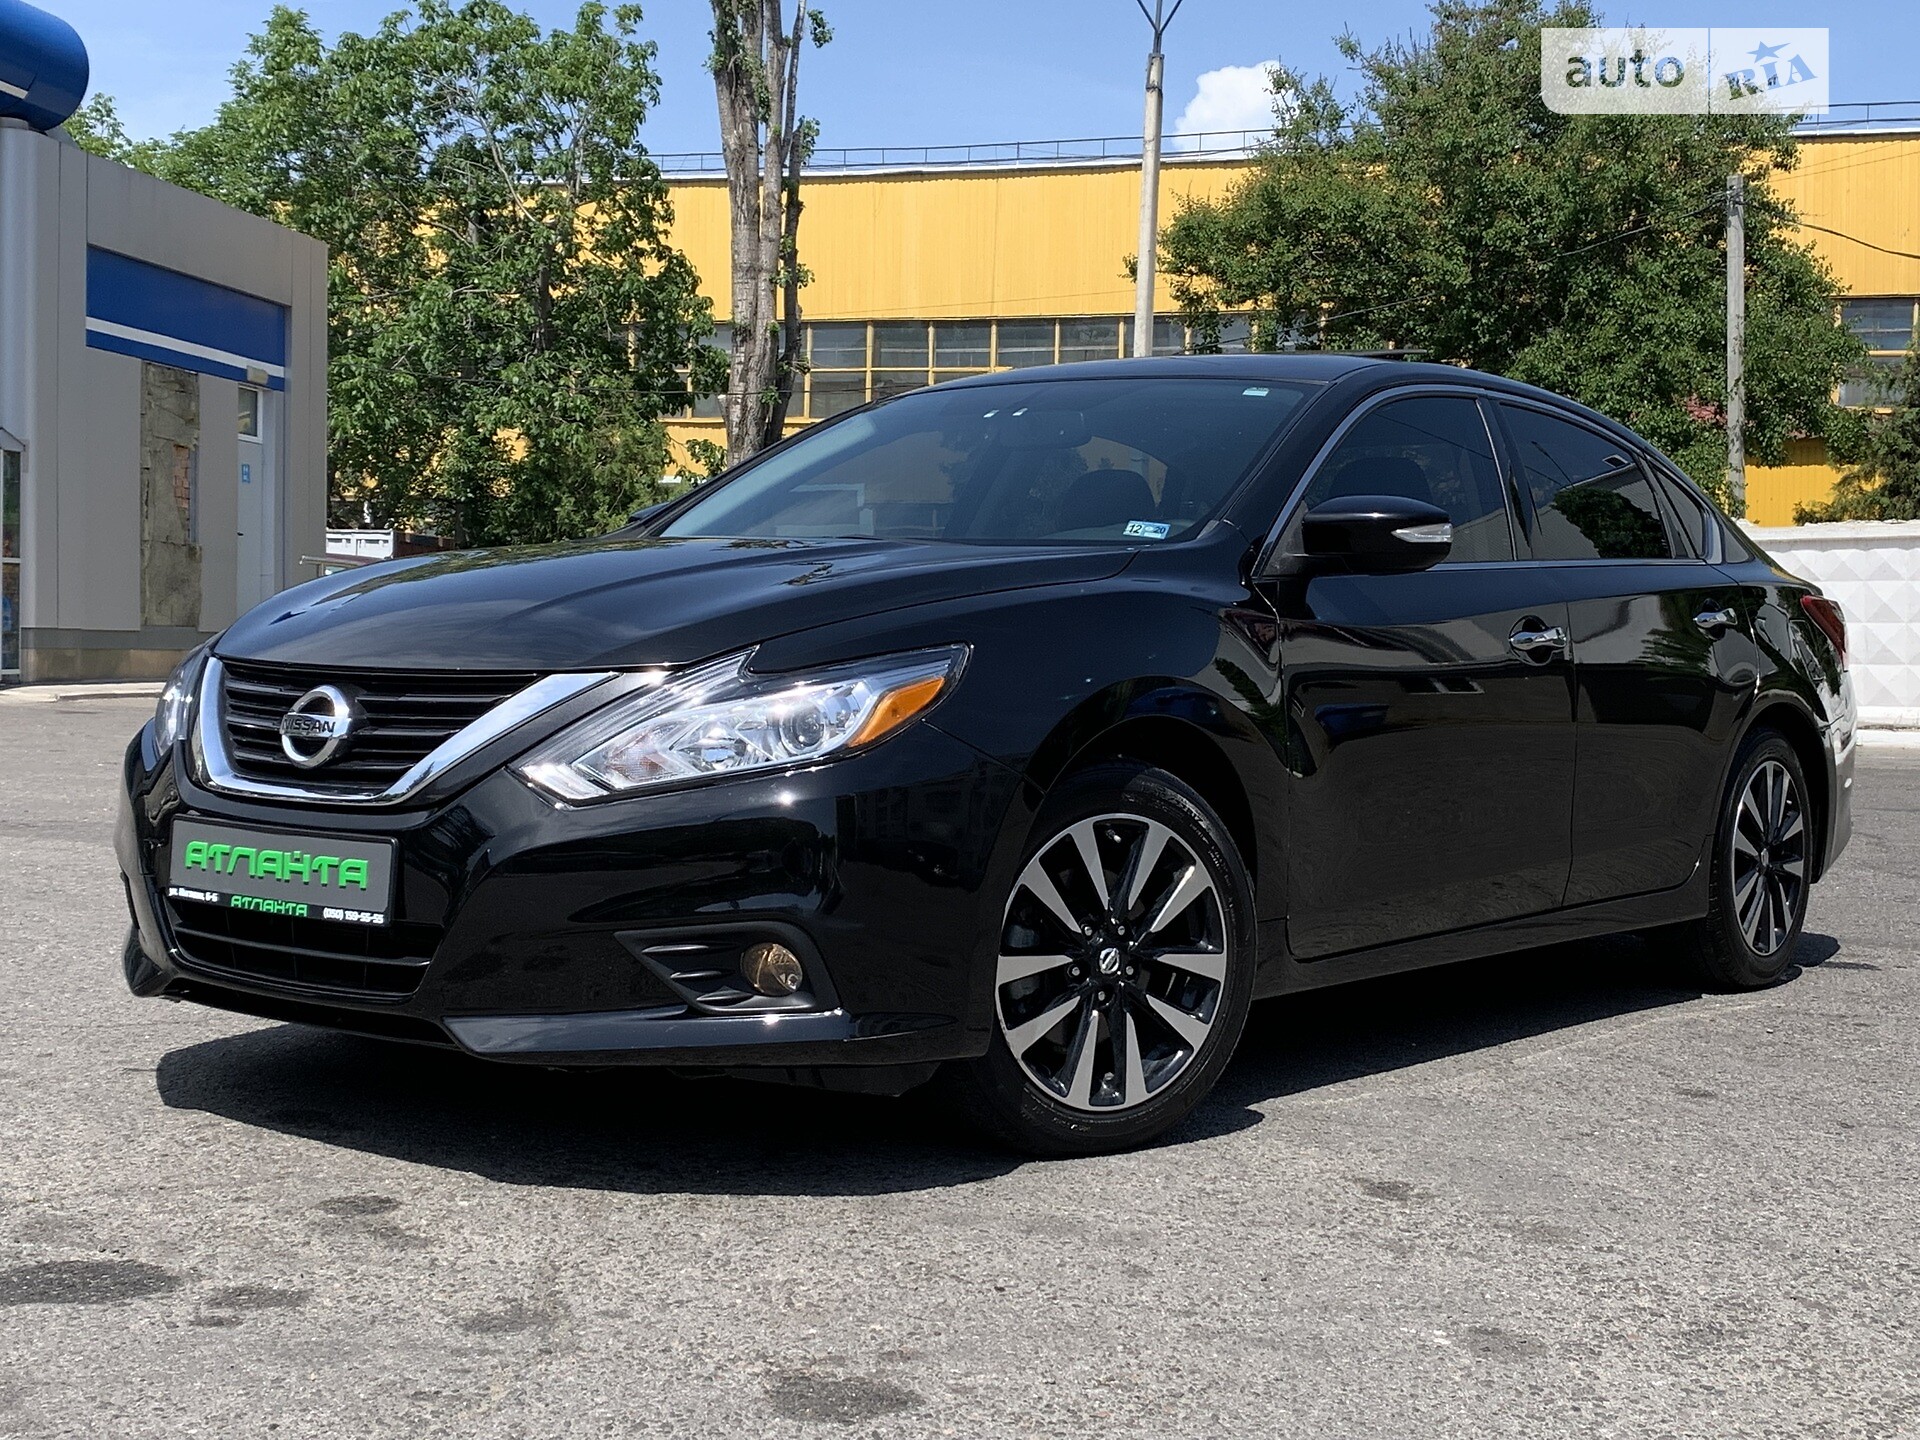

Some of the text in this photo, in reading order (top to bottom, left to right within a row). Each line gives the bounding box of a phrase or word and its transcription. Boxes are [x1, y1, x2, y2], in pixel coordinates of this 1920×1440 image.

[1129, 524, 1166, 534] 12 20
[282, 718, 336, 733] NISSAN
